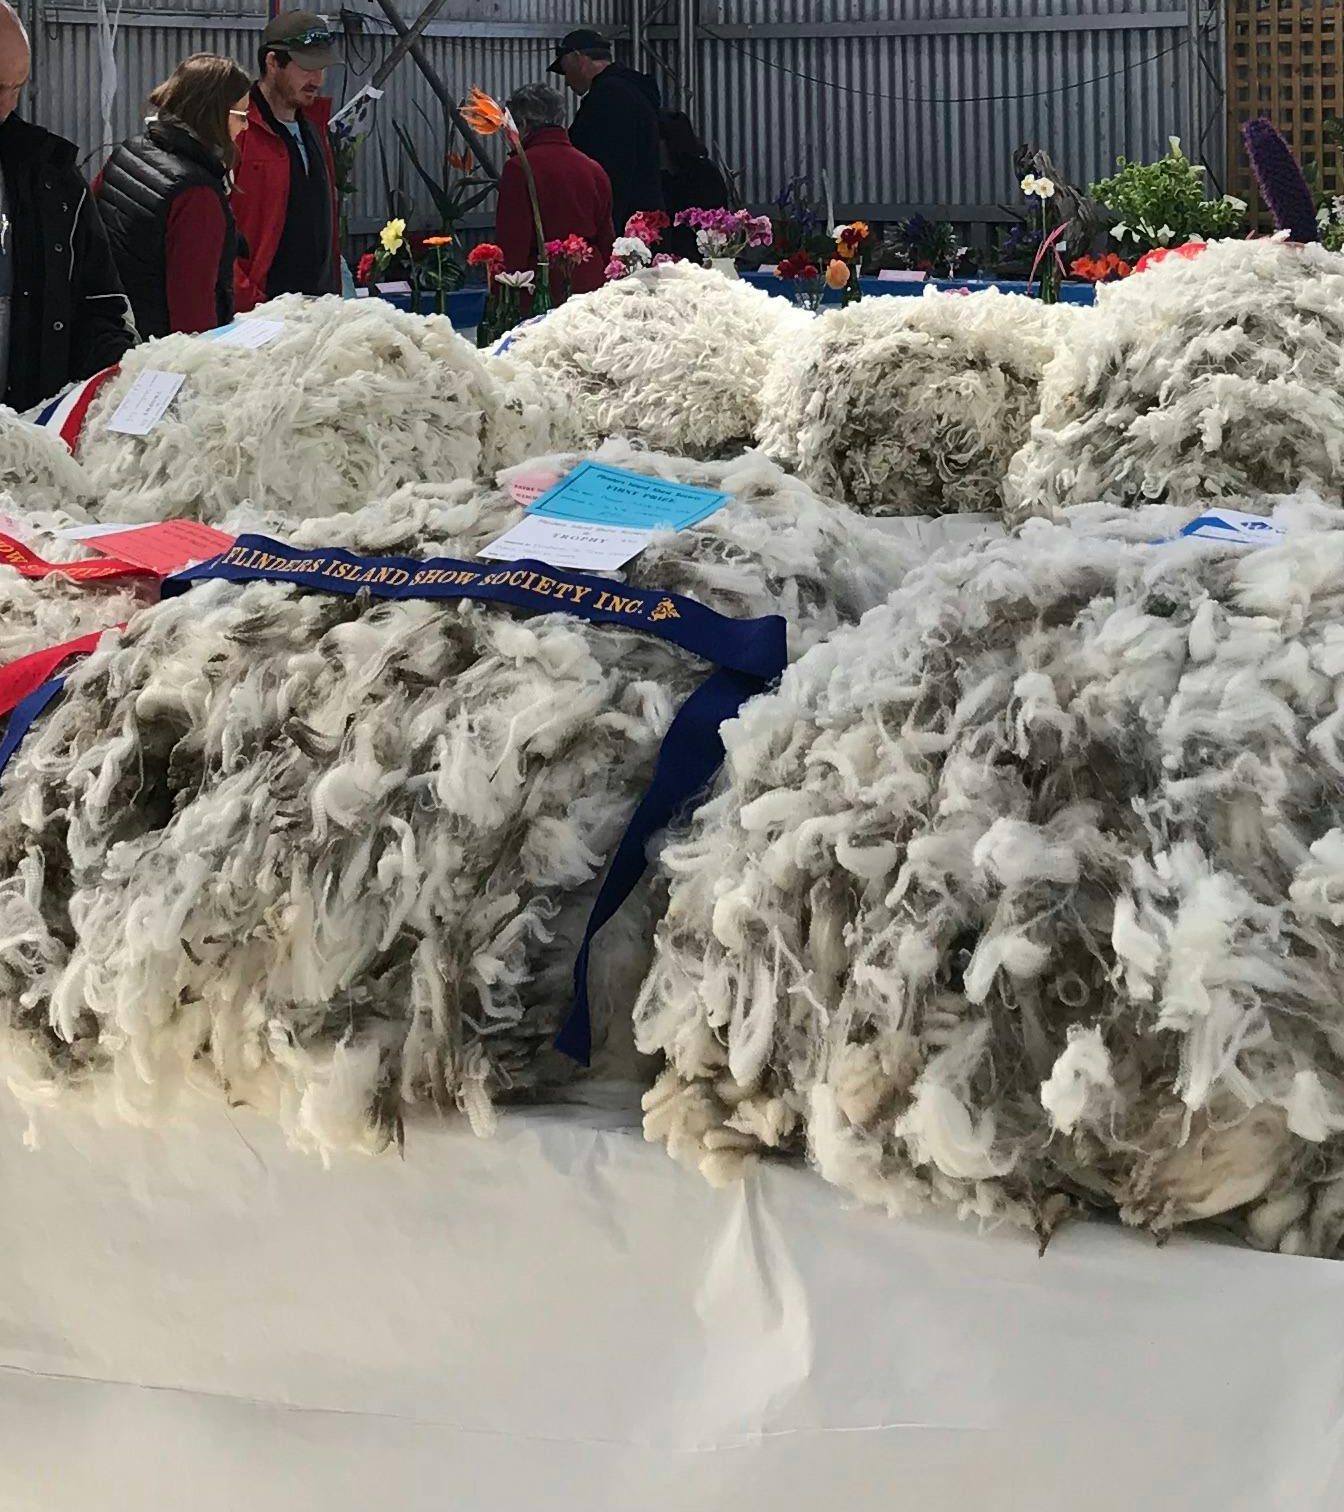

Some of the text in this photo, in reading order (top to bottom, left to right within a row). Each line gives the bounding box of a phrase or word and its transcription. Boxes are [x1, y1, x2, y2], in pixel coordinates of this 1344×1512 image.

[552, 532, 609, 544] TROPHY
[222, 546, 644, 614] FLINDERS ISLAND SHOW SOCIETY INC.
